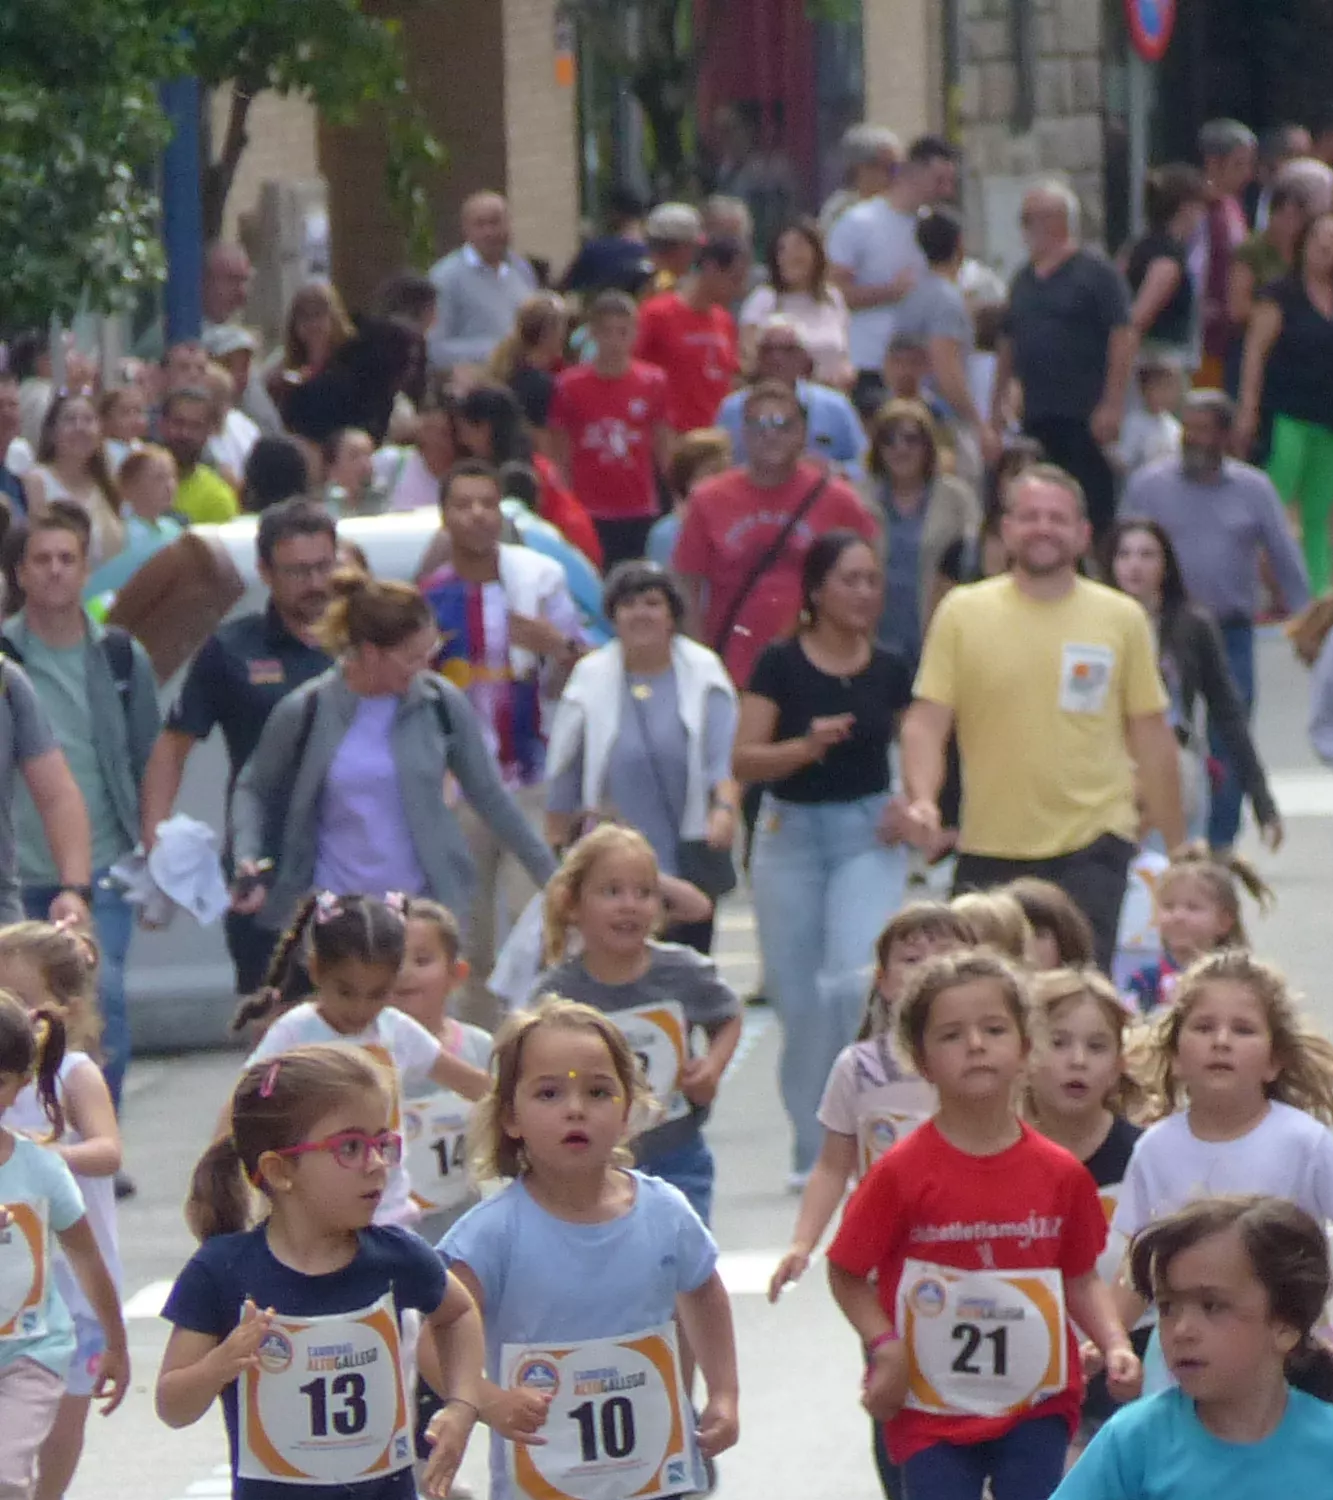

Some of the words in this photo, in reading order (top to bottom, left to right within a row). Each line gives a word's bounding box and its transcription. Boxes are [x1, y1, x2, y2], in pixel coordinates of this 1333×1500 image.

[951, 1321, 1008, 1376] 21
[299, 1372, 368, 1437] 13
[567, 1396, 636, 1462] 10
